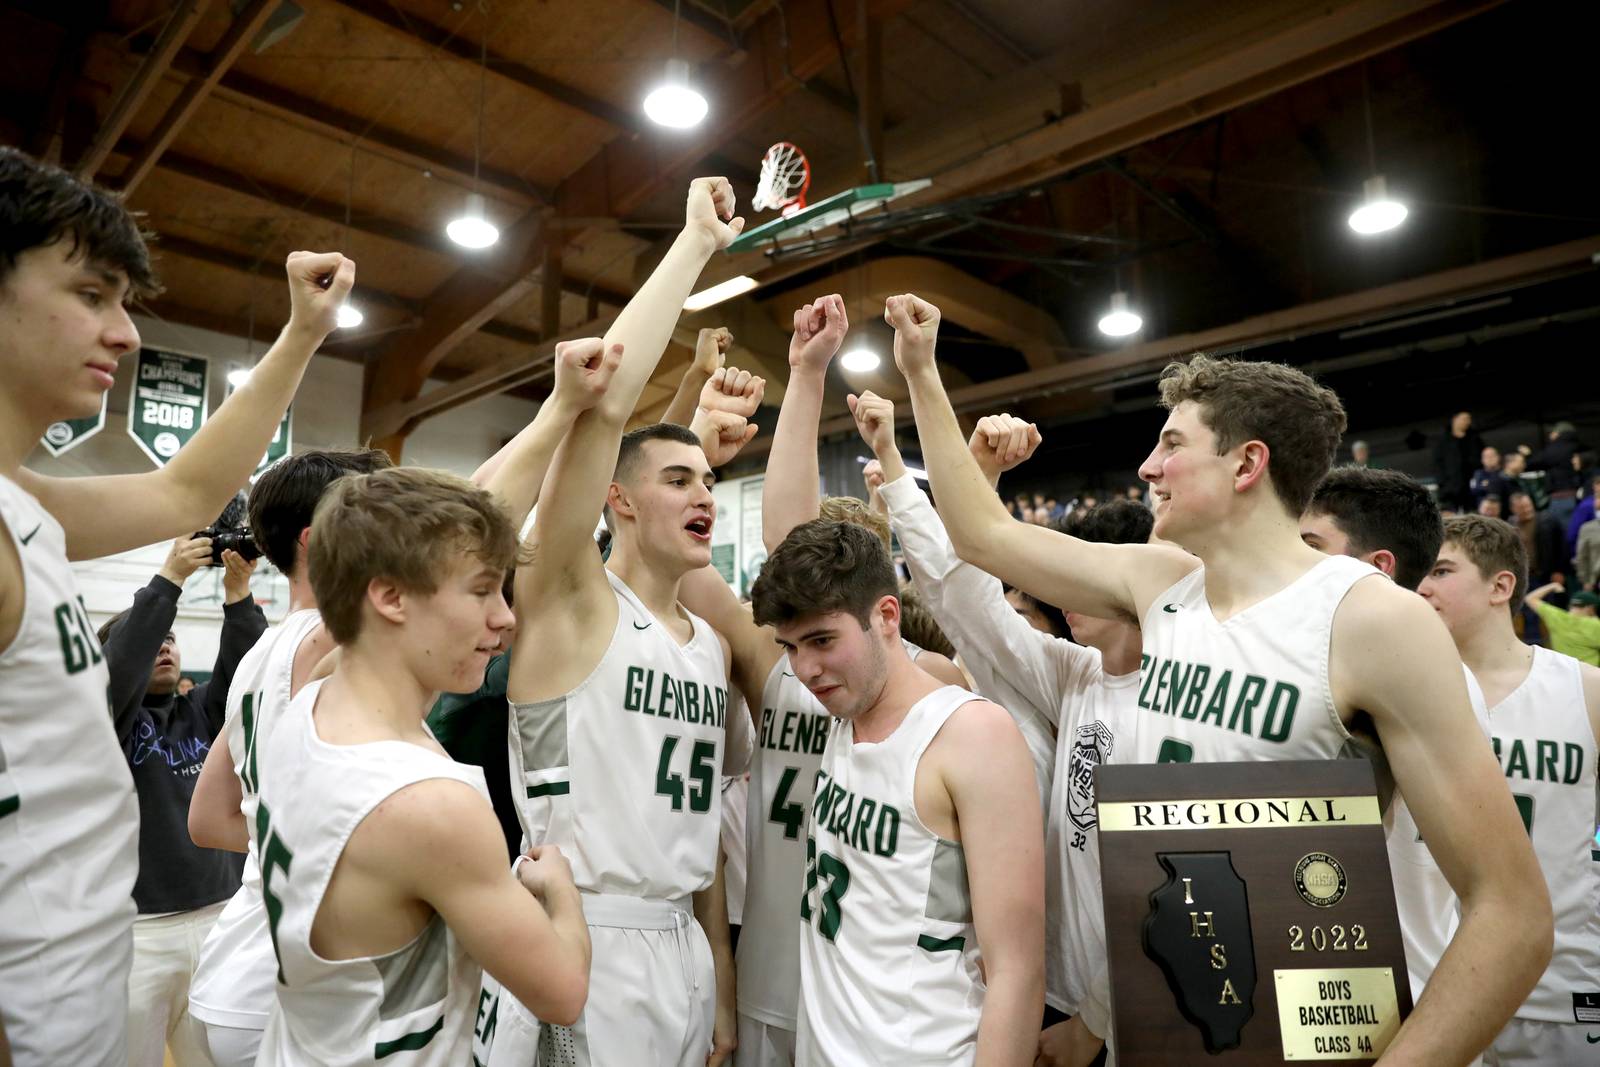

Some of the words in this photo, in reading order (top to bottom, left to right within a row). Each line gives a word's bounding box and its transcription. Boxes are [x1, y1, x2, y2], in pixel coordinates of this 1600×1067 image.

[142, 400, 194, 430] 2018
[624, 666, 728, 729] GLENBAR
[654, 733, 717, 815] 45
[1133, 799, 1346, 828] REGIONAL
[1071, 831, 1087, 852] 32
[1288, 924, 1368, 951] 2022
[1318, 980, 1352, 1000] BOYS
[1299, 1004, 1379, 1026] BASKETBALL
[1314, 1035, 1351, 1054] CLASS
[1357, 1035, 1373, 1053] 4A
